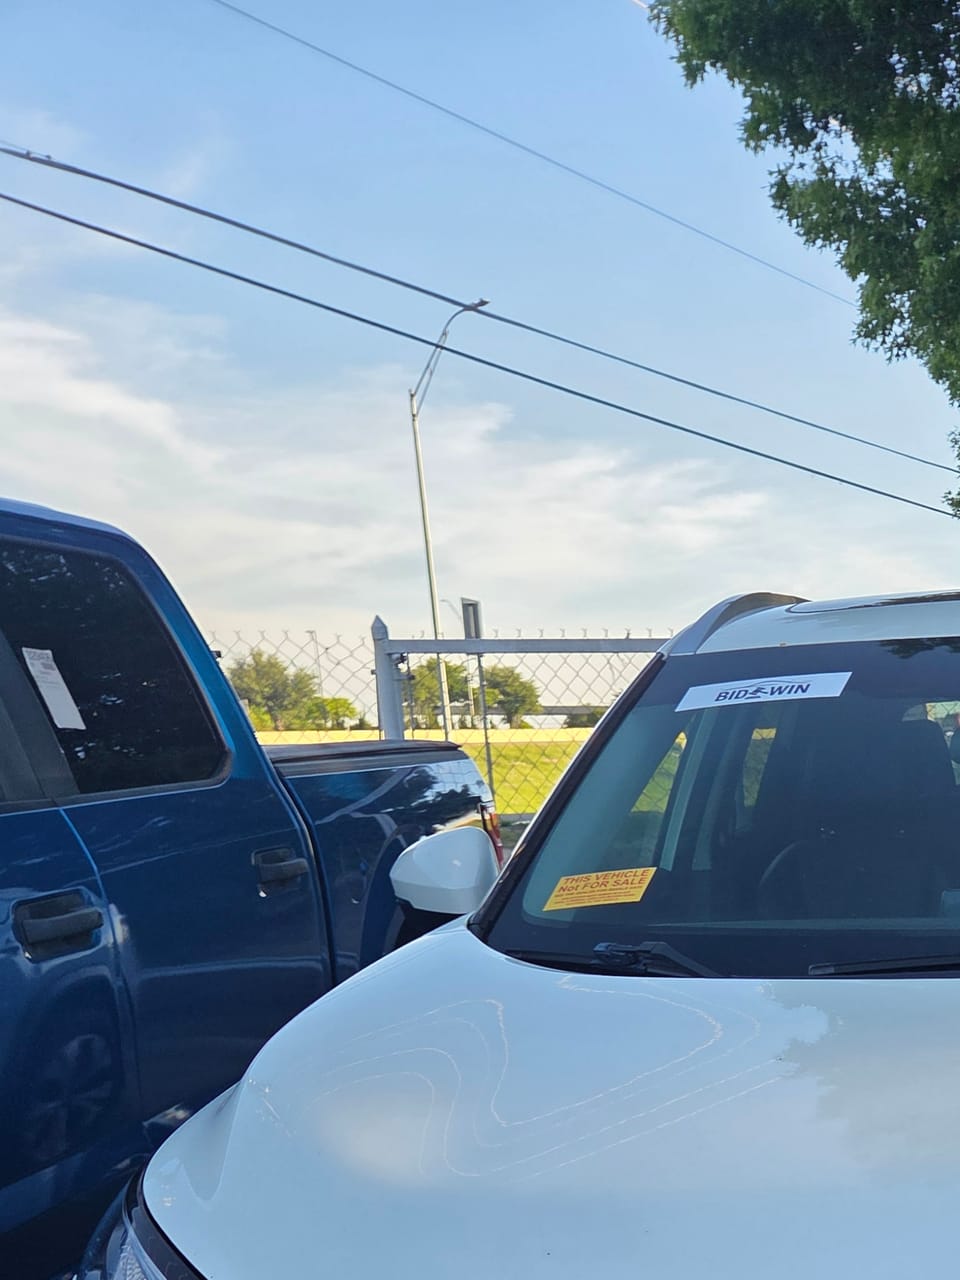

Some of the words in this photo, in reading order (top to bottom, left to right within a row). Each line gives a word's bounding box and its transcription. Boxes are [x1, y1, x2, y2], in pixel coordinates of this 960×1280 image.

[714, 689, 748, 702] BID
[769, 683, 811, 696] WIN
[563, 876, 591, 885] THIS
[595, 869, 650, 881] VEHICLE
[582, 880, 609, 890] FOR
[612, 877, 648, 887] SALE
